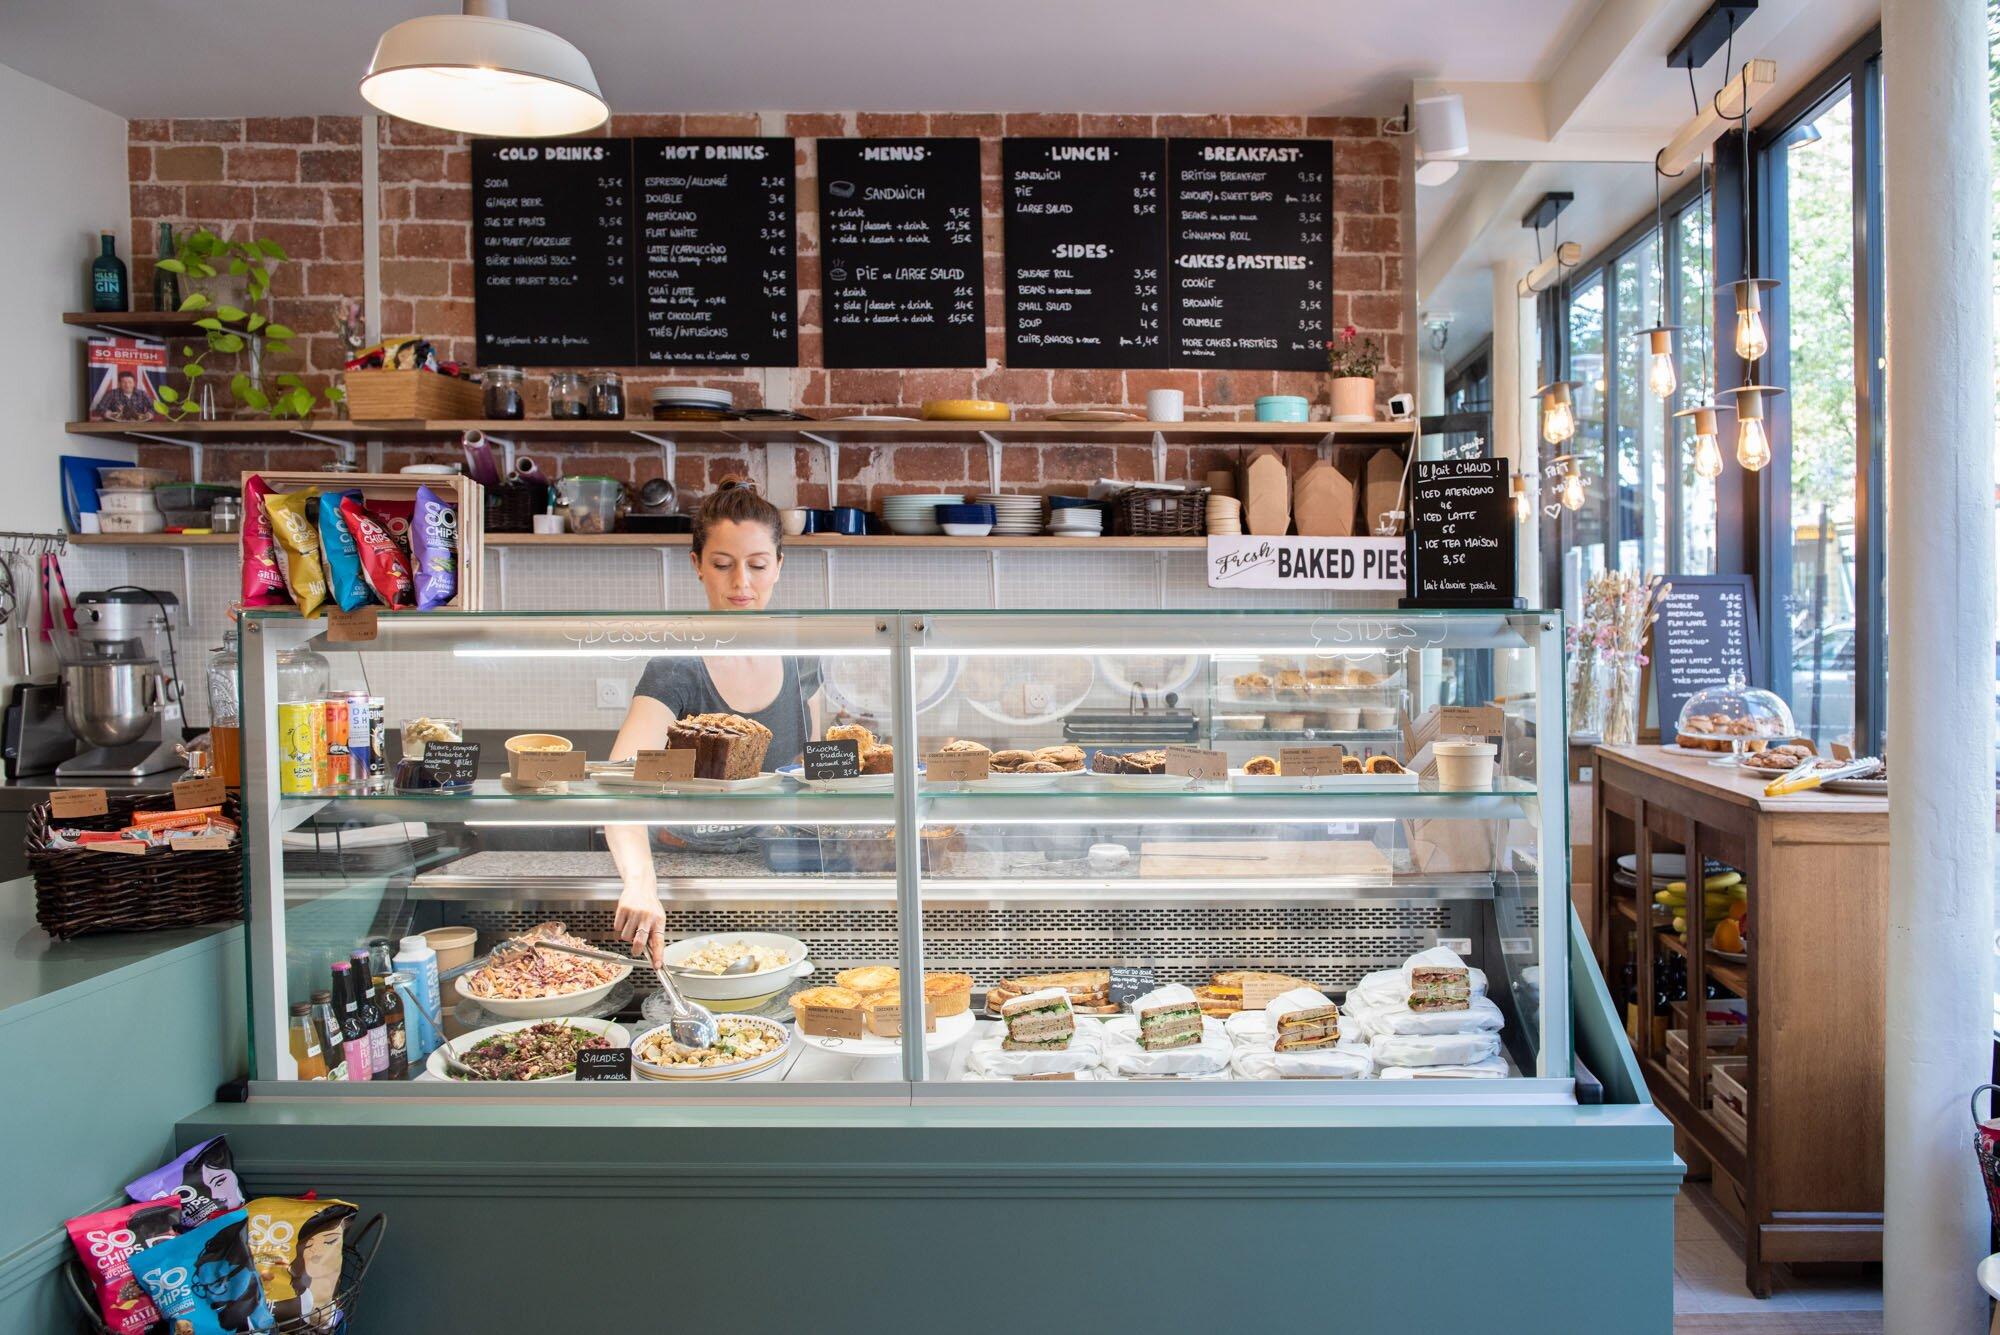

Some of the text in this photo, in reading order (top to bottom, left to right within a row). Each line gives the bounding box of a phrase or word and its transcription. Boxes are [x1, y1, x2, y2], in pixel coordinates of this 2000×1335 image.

[500, 146, 604, 160] COLD DRINKS
[665, 145, 765, 160] HOT DRINKS
[865, 146, 925, 161] MENUS
[1052, 146, 1110, 161] LUNCH
[1204, 146, 1299, 162] BREAKFAST
[1014, 168, 1061, 180] SANDWICH
[1181, 169, 1267, 182] BRITISH BREAKFAST
[484, 178, 508, 188] SODA
[863, 184, 925, 200] SANDWICH
[1014, 185, 1033, 197] PIE
[1221, 192, 1249, 201] SWEET
[486, 198, 544, 208] GINGER BEER
[645, 194, 683, 204] DOUBLE
[838, 208, 864, 218] drink
[1016, 203, 1043, 213] LARGE
[1045, 204, 1073, 214] SALAD
[646, 209, 697, 222] AMERICANO
[1181, 211, 1208, 220] BEANS
[484, 217, 500, 227] JUS
[503, 218, 514, 226] DE
[645, 228, 666, 238] FLAT
[1182, 229, 1225, 240] CINNAMON
[1230, 231, 1251, 241] ROLL
[1056, 244, 1107, 259] SIDES
[1179, 254, 1225, 269] CAKES
[1237, 254, 1306, 270] PASTRIES
[648, 270, 679, 279] MOCHA
[856, 265, 964, 280] PIE LARGE SALAD
[1018, 269, 1050, 279] SAUSAGE
[1053, 269, 1074, 278] ROLL
[96, 281, 119, 293] GIN
[1182, 277, 1216, 288] COOKIE
[672, 287, 695, 295] LATTE
[842, 287, 867, 297] drink
[1018, 285, 1045, 295] BEANS
[1018, 302, 1072, 311] SMALL SALAD
[1183, 296, 1223, 308] BROWNIE
[649, 312, 712, 321] HOT CHOCOLATE
[1019, 318, 1042, 329] SOUP
[1182, 318, 1223, 328] CRUMBLE
[1182, 338, 1203, 347] MORE
[1205, 338, 1231, 347] CAKES
[1239, 337, 1278, 348] PASTRIES
[95, 349, 110, 357] SO
[114, 350, 158, 360] BRITISH
[1431, 464, 1450, 479] fait
[1456, 462, 1491, 475] CHAUD
[1421, 486, 1494, 498] ICED AMERICANO
[425, 501, 457, 528] SO
[1424, 511, 1477, 522] ICED LATTE
[1442, 524, 1456, 534] 5€
[1425, 536, 1498, 549] ICE TEA MAISON
[1215, 541, 1275, 575] Fresh
[1278, 547, 1355, 579] BAKED
[1442, 554, 1466, 565] 3,5€
[820, 751, 856, 760] pudding
[582, 1052, 624, 1063] SALADES
[248, 1214, 294, 1246] SO
[86, 1229, 136, 1257] SO
[142, 1266, 188, 1298] SO
